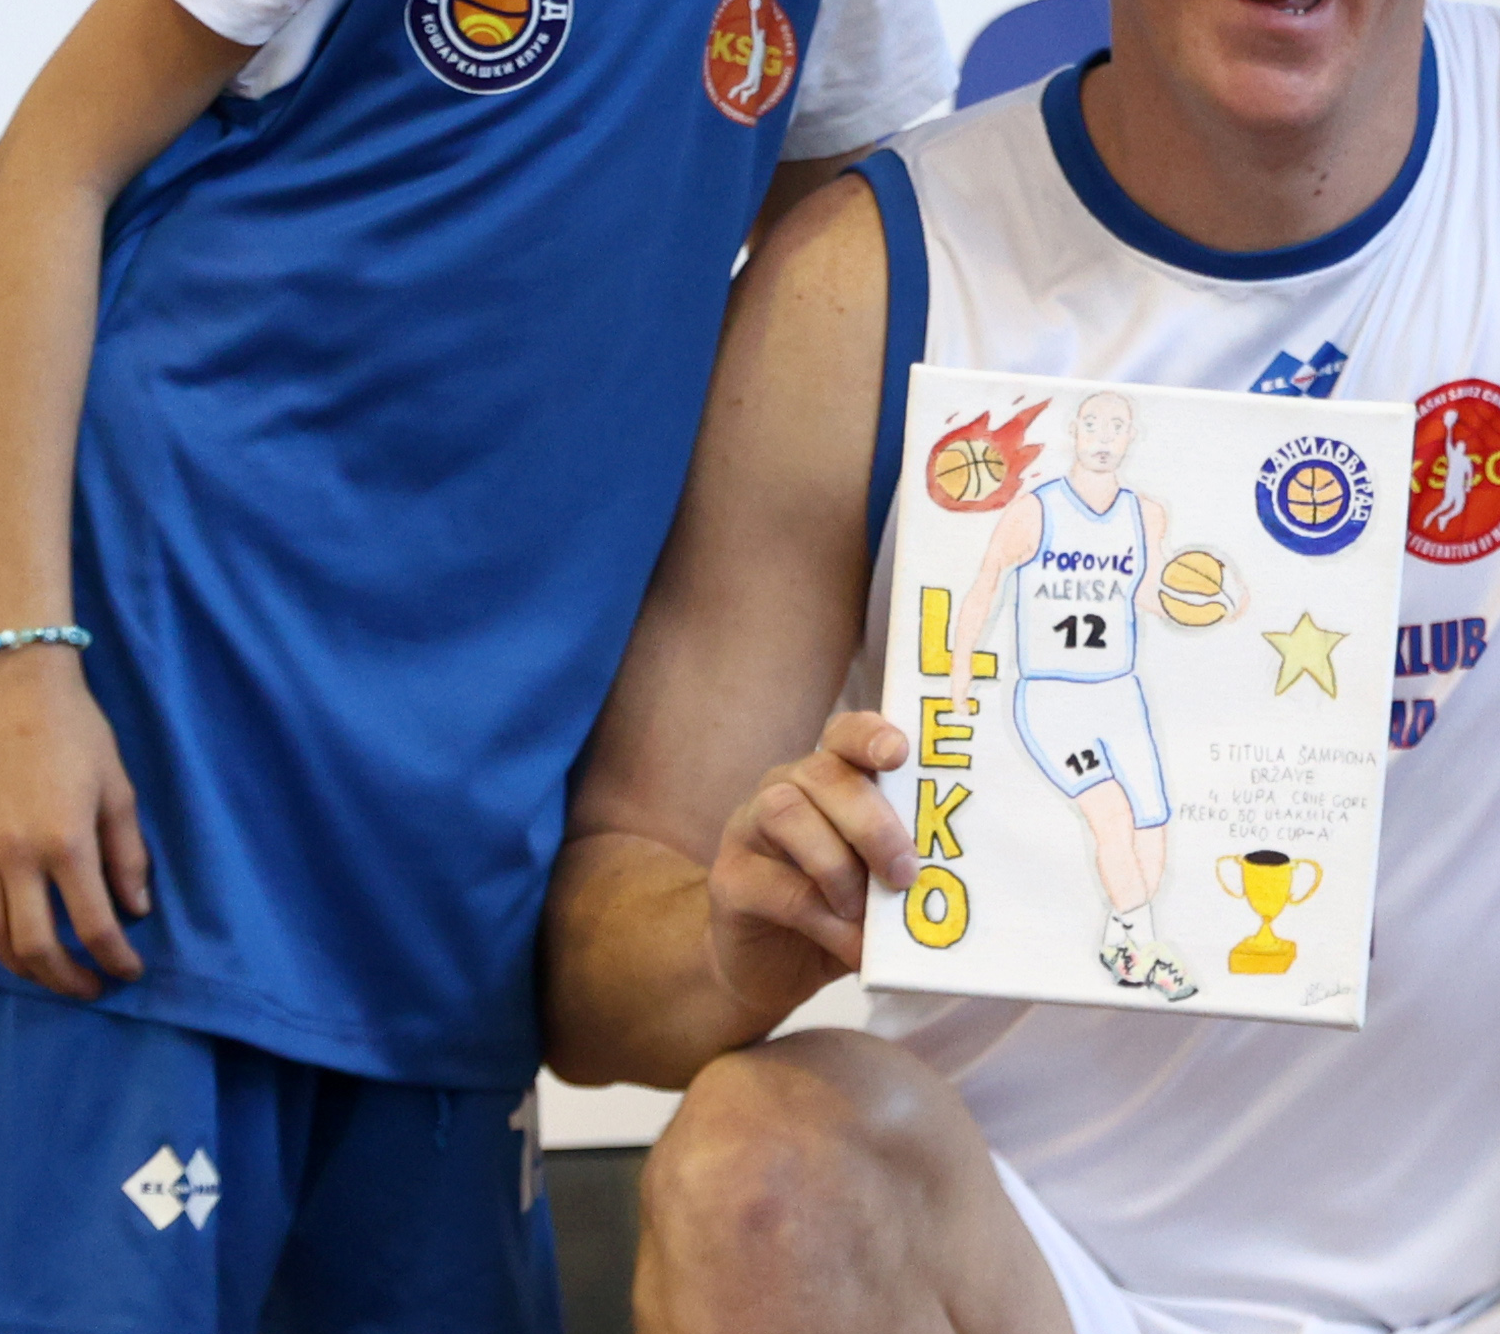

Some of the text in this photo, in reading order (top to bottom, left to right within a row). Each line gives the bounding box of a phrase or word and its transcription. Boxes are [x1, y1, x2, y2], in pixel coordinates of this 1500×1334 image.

[1042, 547, 1134, 575] POPOVIĆ
[1033, 579, 1126, 601] ALEKSA
[1053, 613, 1107, 649] 12
[1065, 748, 1100, 776] 12
[1210, 743, 1220, 762] 5
[1228, 743, 1285, 763] TITULA
[904, 586, 998, 949] LEKO
[1232, 789, 1276, 806] KUPA
[1179, 803, 1228, 822] PREKO
[1229, 823, 1269, 841] EURO
